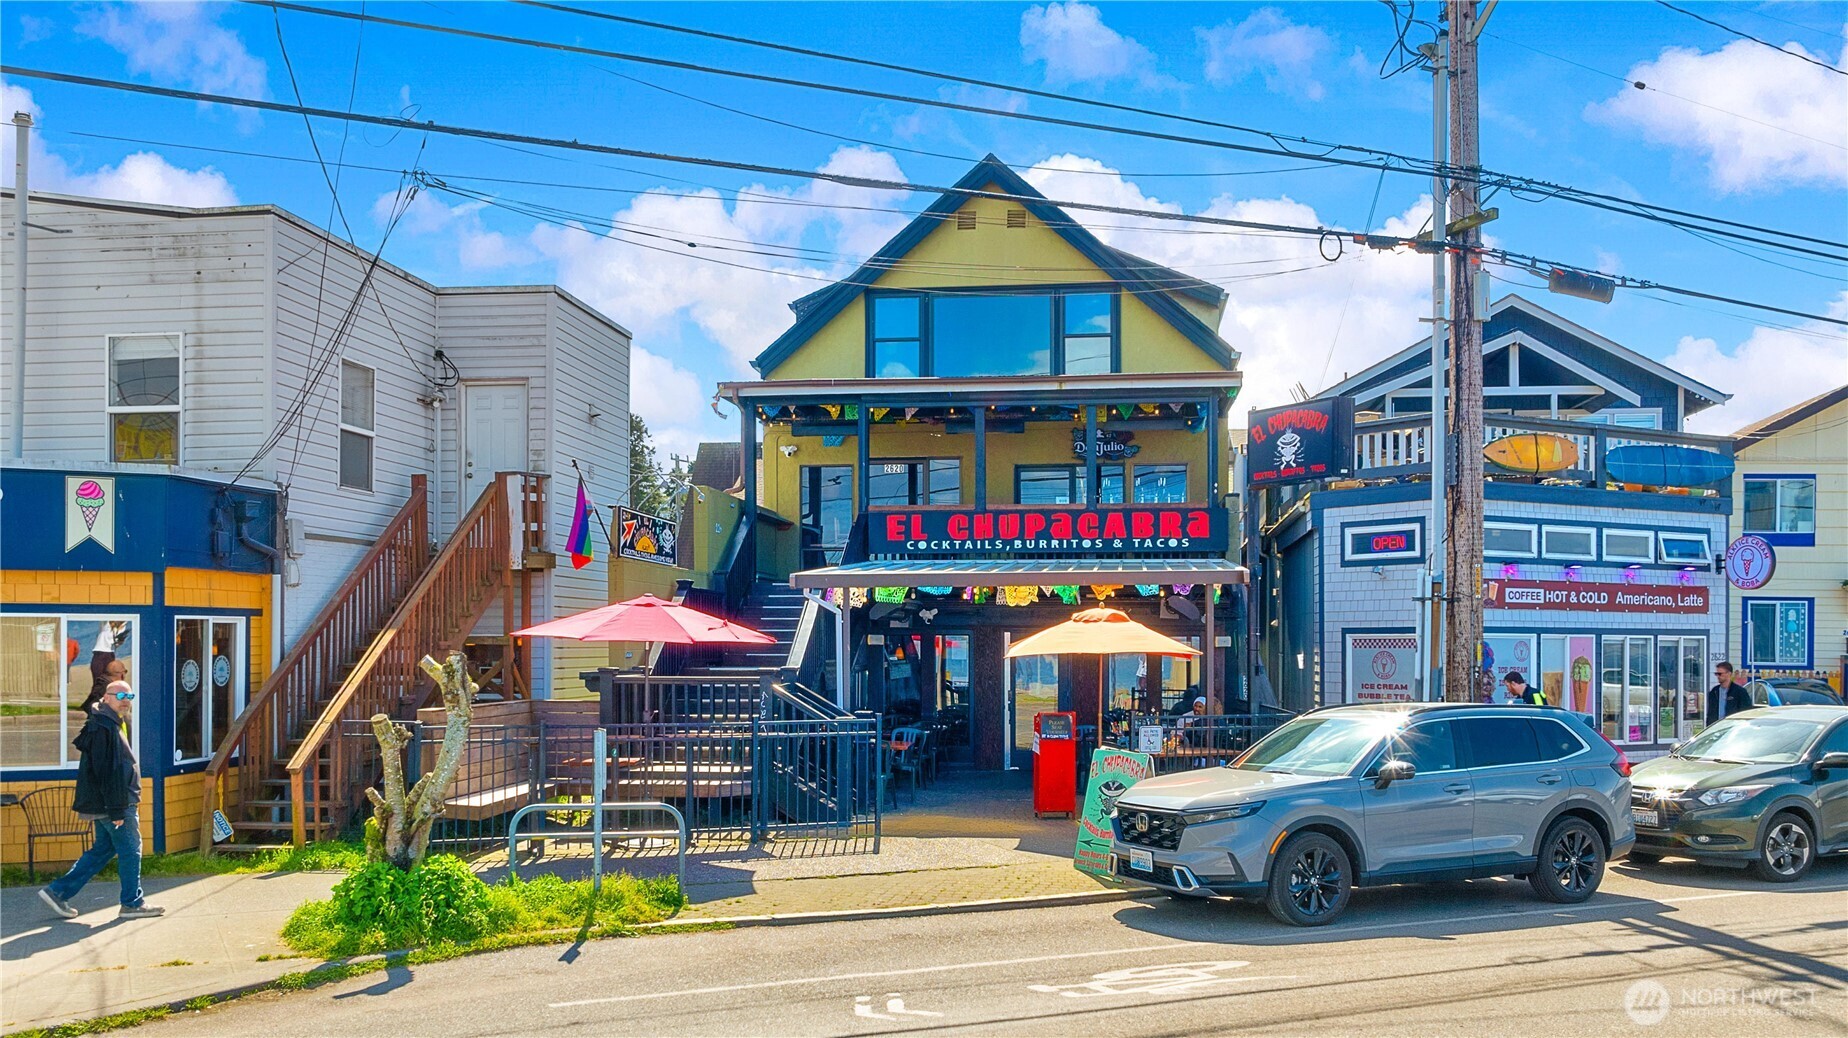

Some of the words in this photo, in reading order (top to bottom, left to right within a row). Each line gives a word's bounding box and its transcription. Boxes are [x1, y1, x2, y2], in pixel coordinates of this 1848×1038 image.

[1251, 424, 1266, 444] EL
[1267, 409, 1329, 435] CHUPACABRA
[1096, 441, 1124, 456] Julio
[884, 464, 905, 473] 2620
[887, 513, 928, 541] EL
[1113, 539, 1123, 548] &
[1133, 538, 1190, 548] TACOS
[1373, 535, 1405, 550] OPEN
[1728, 543, 1739, 560] ALKI
[1739, 538, 1750, 546] ICE
[1751, 538, 1769, 560] CREAM
[1741, 578, 1760, 587] BOBA
[1508, 590, 1542, 600] COFFEE
[1546, 591, 1568, 603] HOT
[1569, 592, 1578, 604] &
[1579, 592, 1608, 604] COLD
[1615, 593, 1676, 608] Americano,
[1678, 594, 1704, 606] Latte
[214, 811, 232, 836] NOTICE
